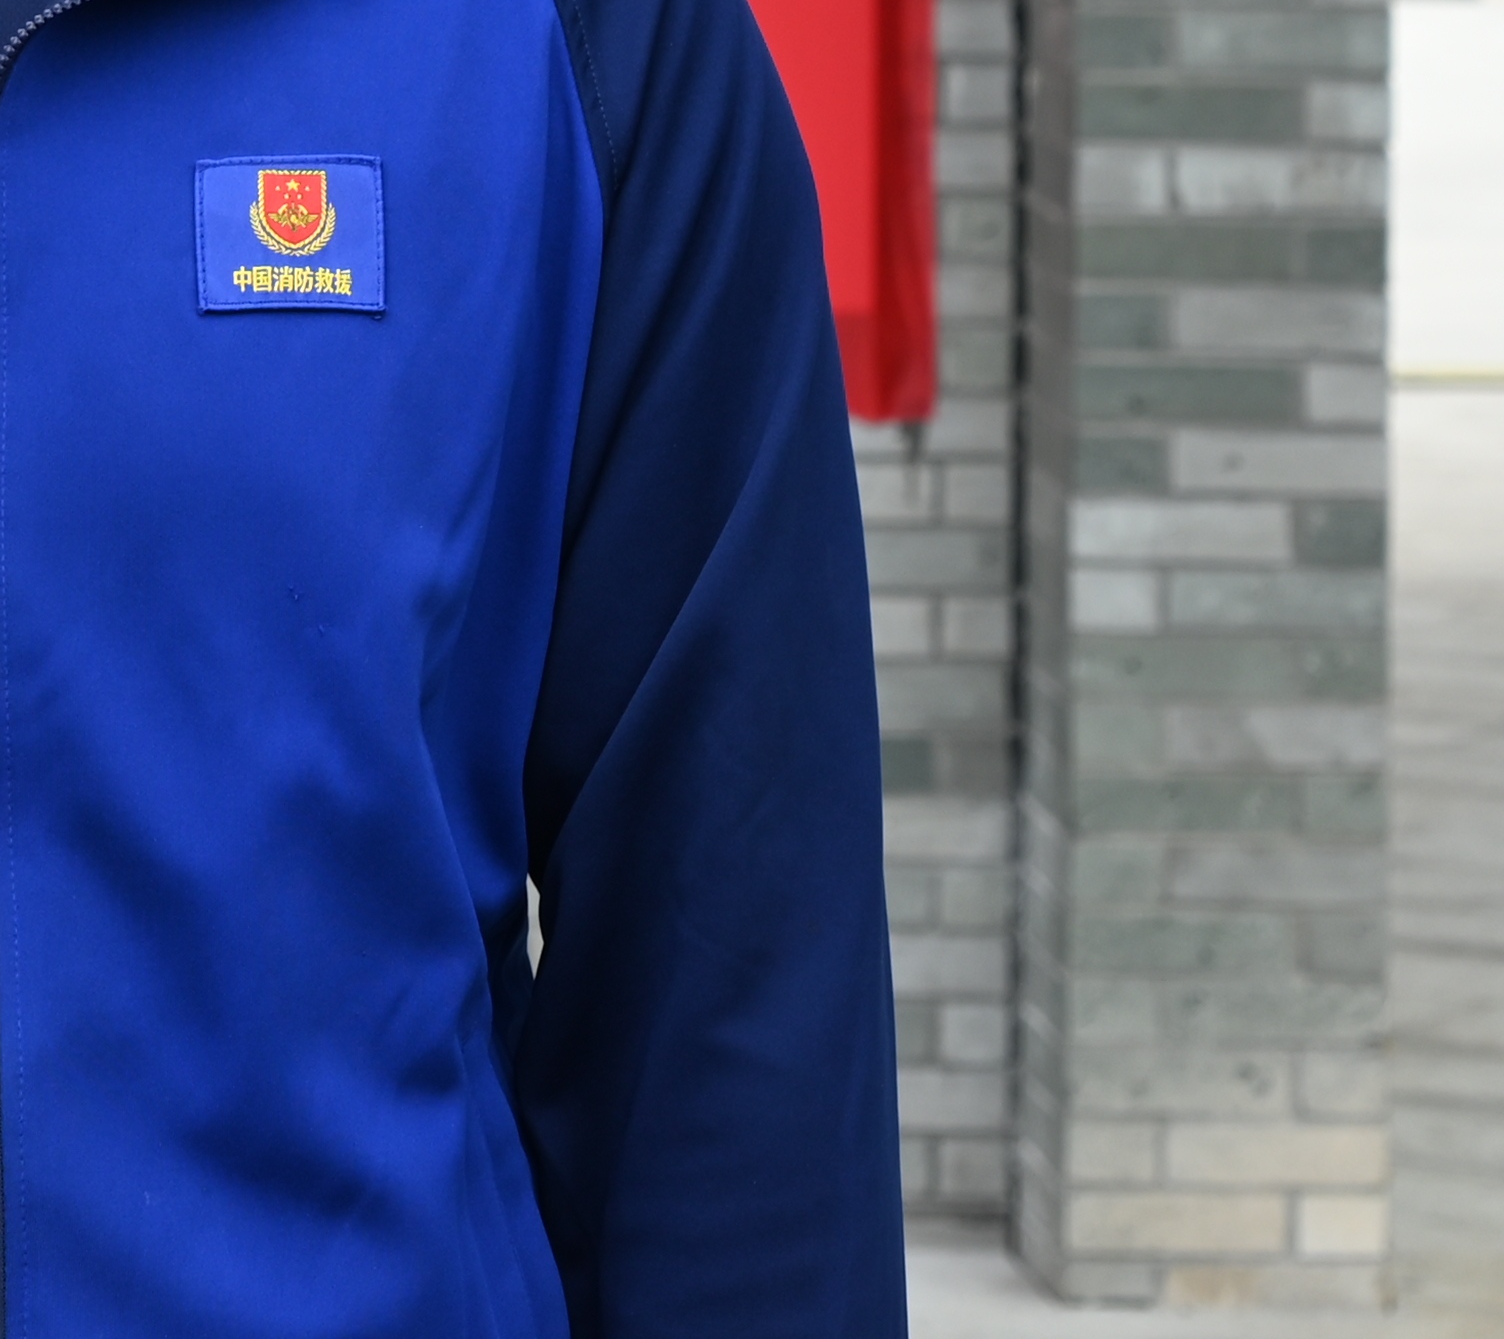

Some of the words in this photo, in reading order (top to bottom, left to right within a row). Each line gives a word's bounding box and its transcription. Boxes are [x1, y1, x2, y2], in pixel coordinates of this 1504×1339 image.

[232, 265, 353, 296] 中国消防救援
